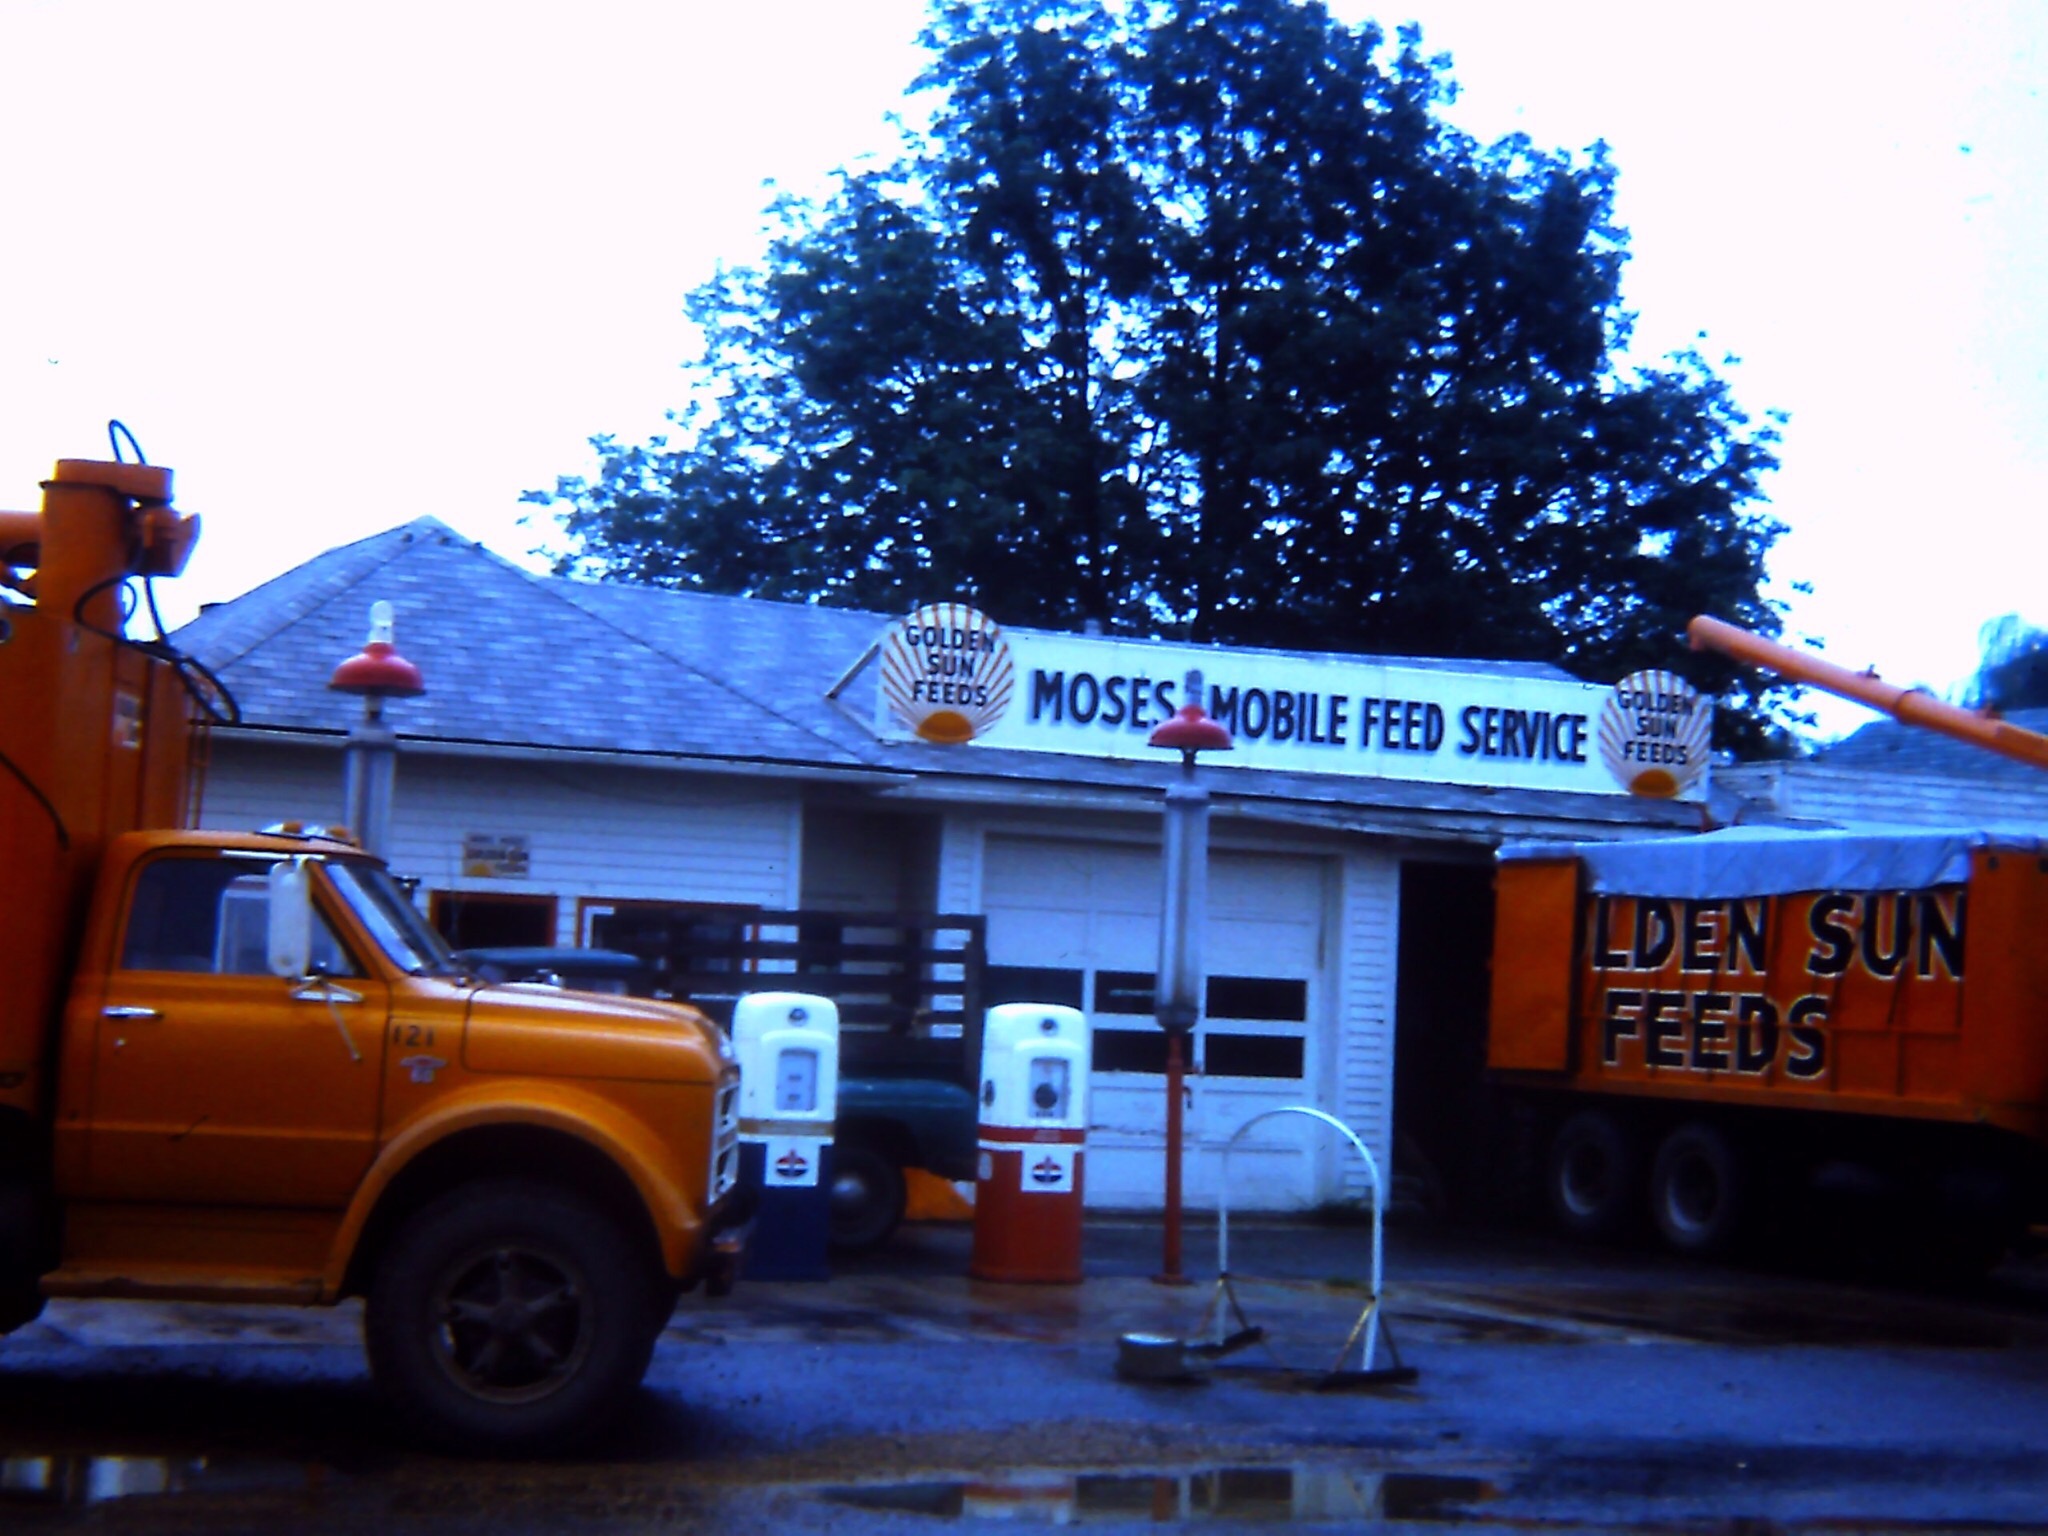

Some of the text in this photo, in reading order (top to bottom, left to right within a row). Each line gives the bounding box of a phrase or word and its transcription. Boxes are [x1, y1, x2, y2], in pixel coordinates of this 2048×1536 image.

[906, 625, 994, 653] GOLDEN
[927, 654, 975, 677] SUN
[912, 680, 988, 707] FEEDS
[1618, 690, 1693, 716] GOLDEN
[1031, 669, 1588, 763] MOSES MOBILE FEED SERVICE
[1636, 716, 1677, 738] SUN
[1624, 741, 1688, 765] FEEDS
[1804, 889, 1964, 981] SUN
[392, 1024, 435, 1048] 121
[1604, 988, 1828, 1080] FEEDS
